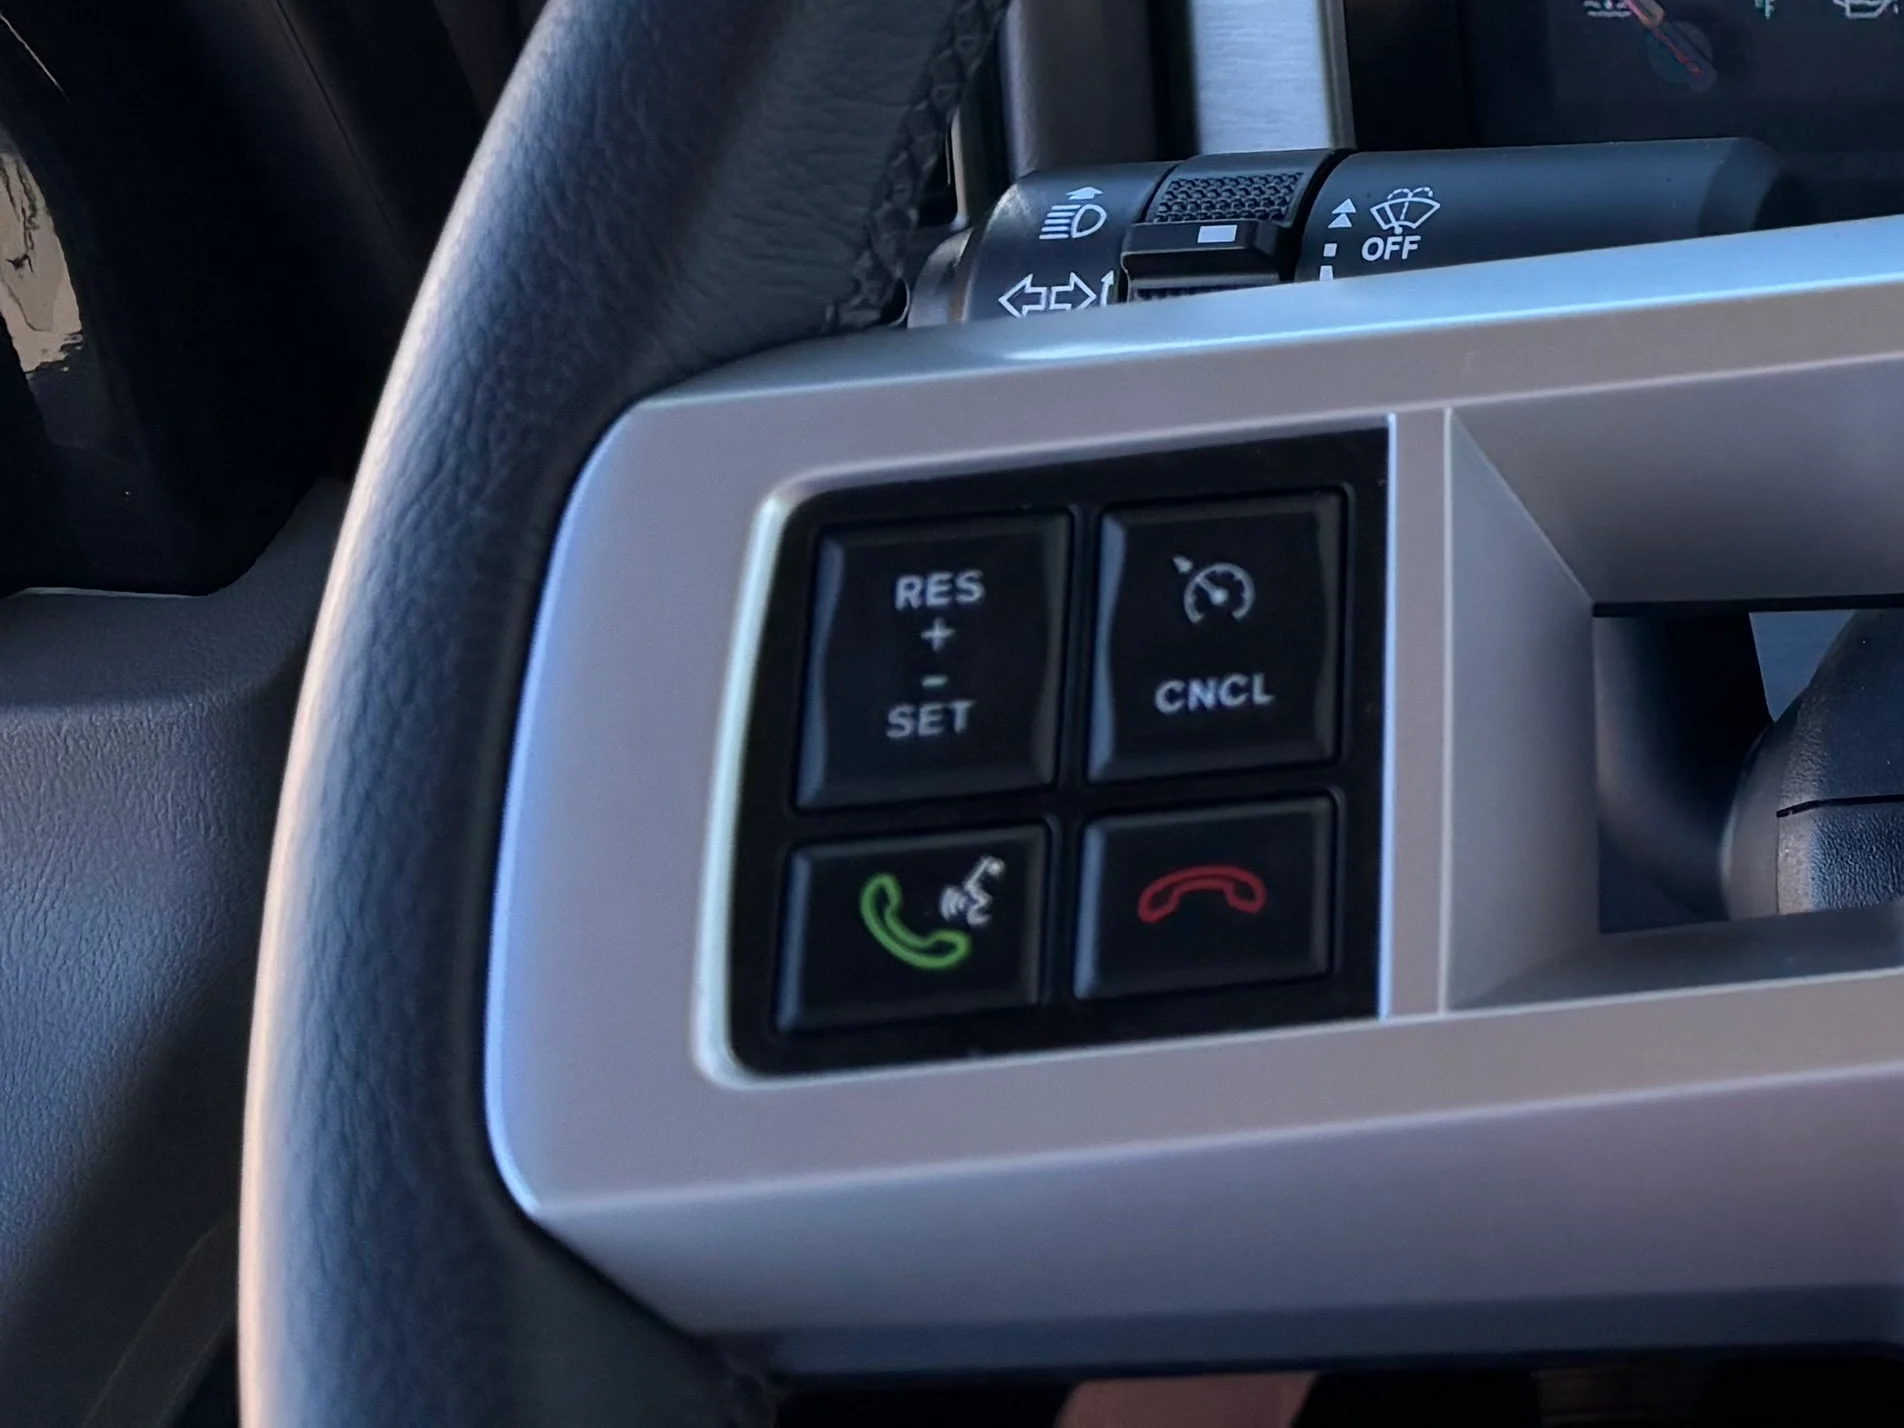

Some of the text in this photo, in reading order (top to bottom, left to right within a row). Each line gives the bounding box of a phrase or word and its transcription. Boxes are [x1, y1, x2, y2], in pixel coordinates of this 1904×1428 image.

[1361, 235, 1422, 262] OFF
[895, 571, 983, 609] RES
[1155, 675, 1271, 713] CNCL
[886, 700, 971, 739] SET
